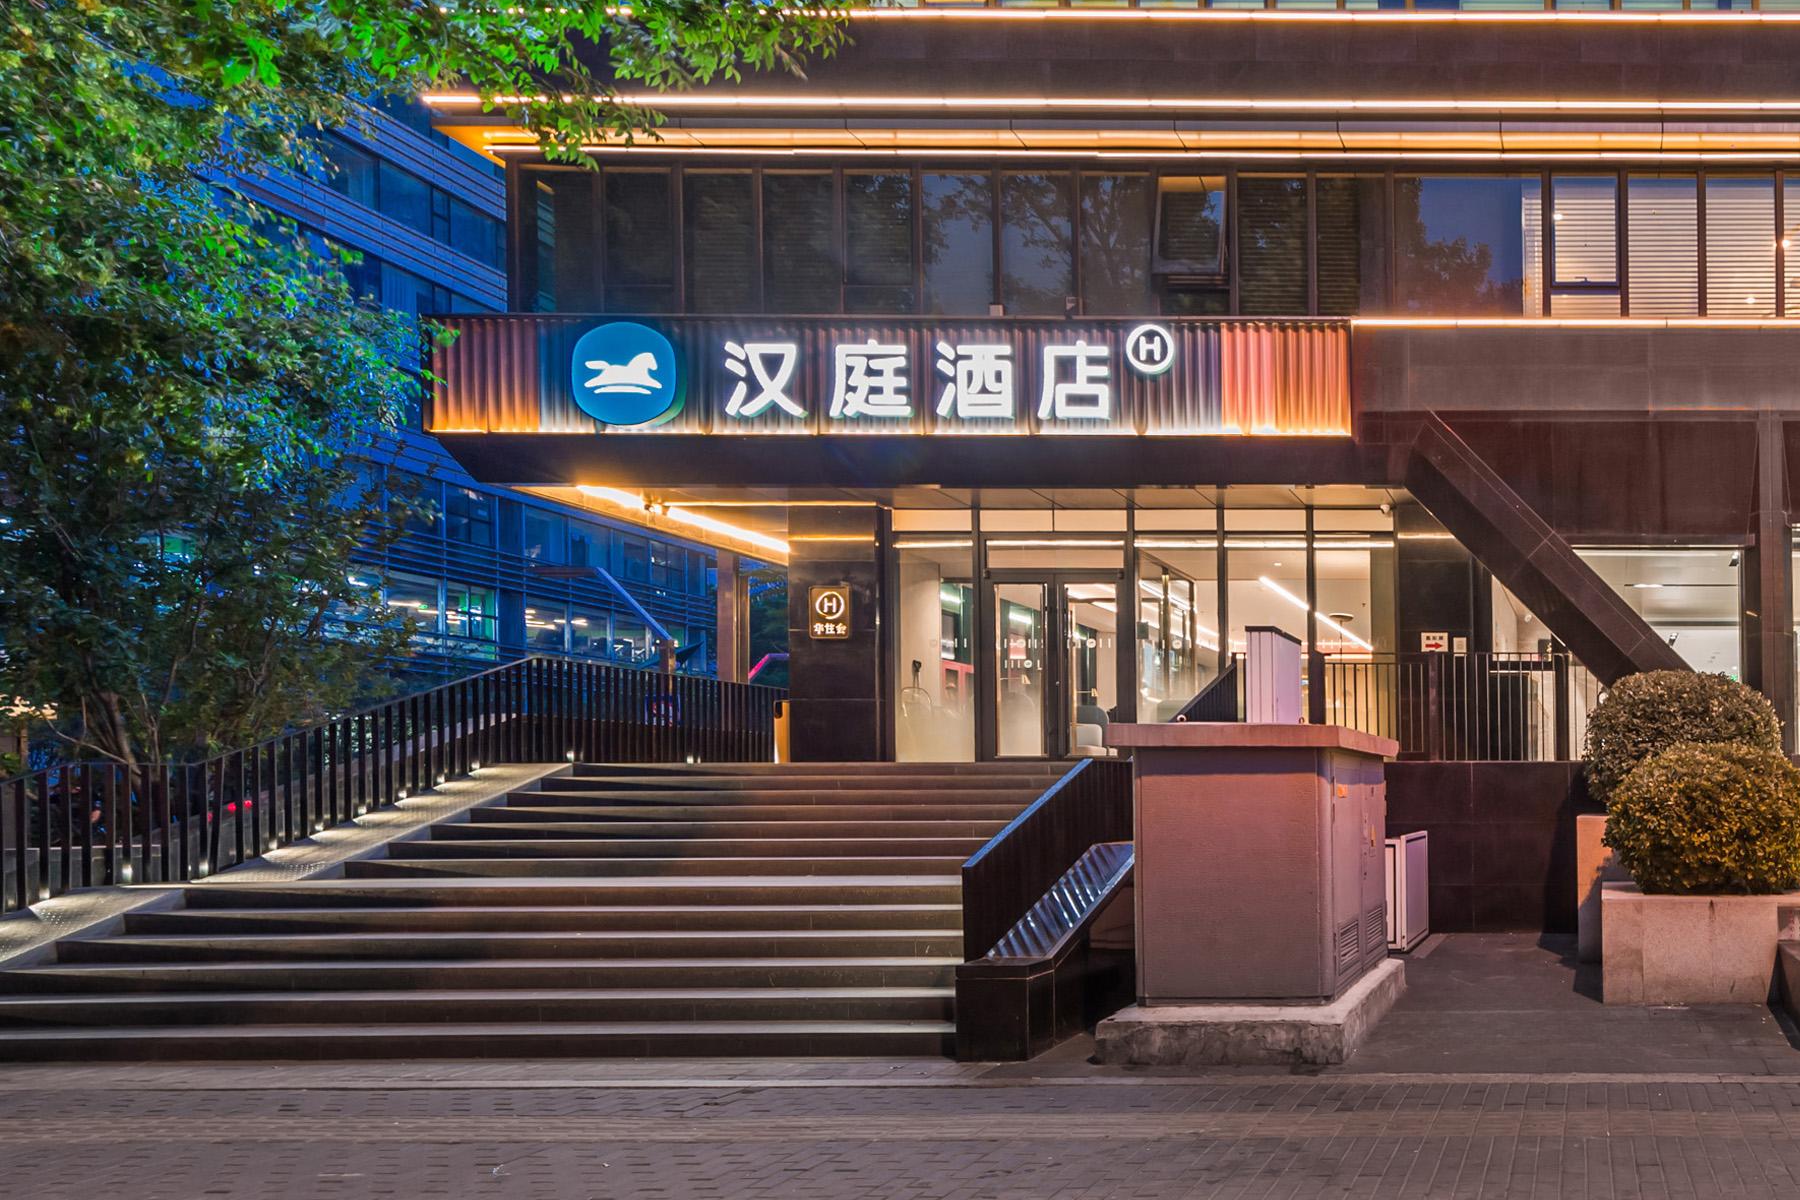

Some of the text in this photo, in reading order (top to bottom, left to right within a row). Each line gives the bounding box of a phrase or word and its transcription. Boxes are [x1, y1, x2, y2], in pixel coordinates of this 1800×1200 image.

[724, 339, 1111, 419] 汉庭酒店
[813, 622, 847, 635] 华住会
